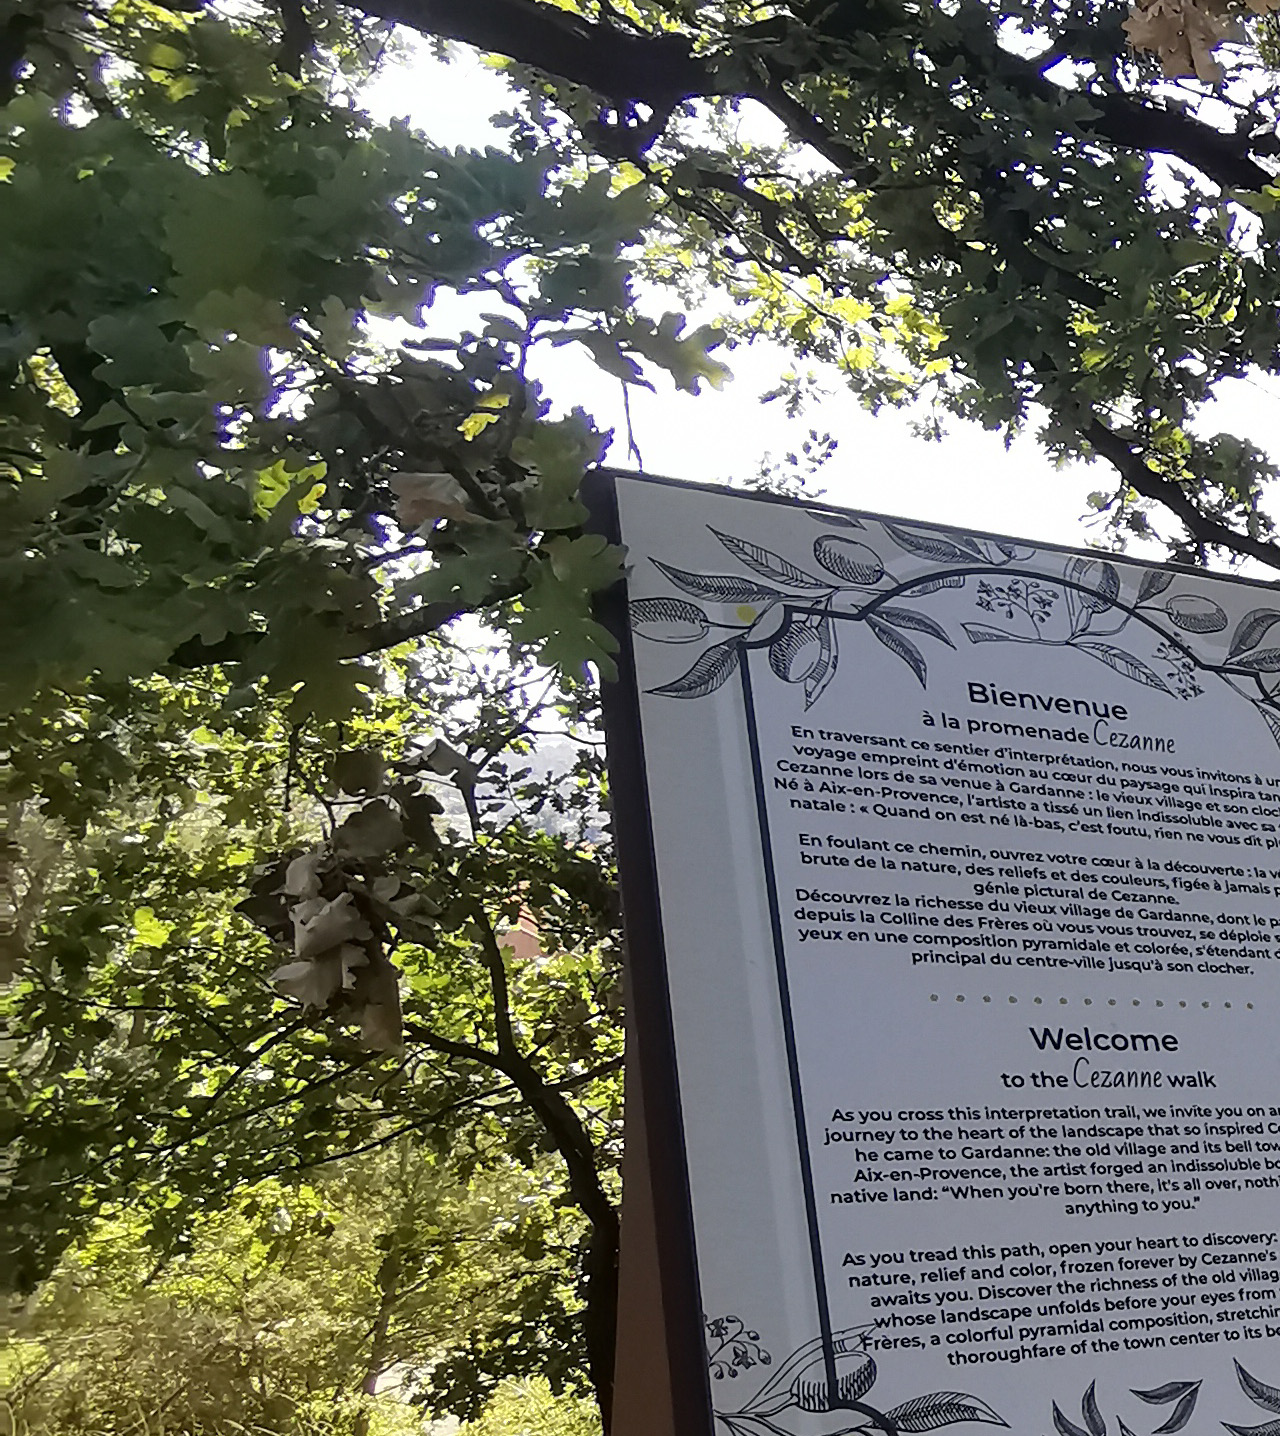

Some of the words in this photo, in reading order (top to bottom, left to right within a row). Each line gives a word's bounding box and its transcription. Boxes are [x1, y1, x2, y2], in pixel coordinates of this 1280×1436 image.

[967, 681, 1128, 721] Bienvenue
[922, 709, 936, 727] à
[941, 711, 961, 730] la
[966, 718, 1090, 744] promenade
[1093, 718, 1176, 754] Cezanne
[790, 725, 815, 740] En
[817, 729, 908, 749] traversant
[910, 740, 930, 751] ce
[933, 742, 991, 757] sentier
[993, 747, 1119, 773] d'interprétation,
[1121, 762, 1158, 775] nous
[1159, 766, 1195, 779] vous
[1195, 767, 1252, 785] invitons
[1254, 773, 1263, 786] à
[792, 744, 857, 763] voyage
[861, 752, 941, 769] empreint
[943, 758, 1026, 778] d'émotion
[1028, 769, 1049, 780] au
[1051, 771, 1093, 784] cœur
[1095, 773, 1117, 787] du
[1119, 778, 1180, 795] paysage
[1182, 783, 1207, 797] qui
[1208, 783, 1257, 801] inspira
[795, 888, 892, 906] Découvrez
[894, 893, 911, 907] la
[914, 894, 984, 911] richesse
[987, 898, 1010, 913] du
[1013, 900, 1058, 916] vieux
[1059, 902, 1111, 920] village
[1114, 906, 1135, 920] de
[1137, 908, 1215, 926] Gardanne,
[1215, 912, 1251, 926] dont
[1252, 913, 1267, 927] le
[973, 880, 1020, 896] génie
[1023, 883, 1085, 900] pictural
[1087, 887, 1108, 901] de
[1110, 889, 1180, 906] Cezanne.
[797, 928, 844, 943] yeux
[846, 931, 870, 942] en
[873, 931, 909, 944] une
[912, 933, 1018, 949] composition
[1021, 937, 1111, 953] pyramidale
[1114, 941, 1131, 953] et
[1133, 941, 1193, 958] colorée,
[1195, 944, 1272, 960] s'étendant
[911, 949, 987, 968] principal
[989, 952, 1013, 966] du
[1015, 955, 1106, 970] centre-ville
[1107, 956, 1164, 974] jusqu'à
[1166, 962, 1194, 973] son
[1196, 961, 1255, 976] clocher.
[1028, 1026, 1179, 1052] Welcome
[1000, 1072, 1025, 1089] to
[1029, 1070, 1069, 1088] the
[1073, 1056, 1163, 1089] Cezanne
[1166, 1070, 1217, 1088] walk
[823, 1127, 896, 1146] journey
[898, 1128, 919, 1141] to
[922, 1126, 954, 1141] the
[957, 1126, 1006, 1140] heart
[1008, 1125, 1026, 1139] of
[1028, 1124, 1058, 1139] the
[1061, 1123, 1144, 1140] landscape
[1146, 1123, 1181, 1137] that
[1183, 1125, 1202, 1136] so
[1203, 1121, 1265, 1138] inspired
[831, 1108, 855, 1122] As
[857, 1110, 893, 1125] you
[897, 1110, 945, 1121] cross
[947, 1106, 982, 1121] this
[984, 1105, 1101, 1123] interpretation
[1103, 1104, 1141, 1121] trail,
[1142, 1108, 1167, 1118] we
[1169, 1104, 1213, 1118] invite
[1214, 1107, 1244, 1120] you
[1246, 1107, 1266, 1117] on
[853, 1167, 1007, 1183] Aix-en-Provence,
[1009, 1163, 1040, 1178] the
[1042, 1161, 1088, 1177] artist
[1089, 1160, 1144, 1178] forged
[1147, 1163, 1168, 1174] an
[1169, 1157, 1262, 1173] indissoluble
[1064, 1198, 1139, 1218] anything
[1141, 1199, 1159, 1212] to
[1160, 1195, 1201, 1214] you."
[848, 1272, 916, 1288] nature,
[920, 1266, 967, 1284] relief
[970, 1263, 1005, 1280] and
[1009, 1262, 1057, 1278] color,
[1059, 1259, 1115, 1275] frozen
[1117, 1256, 1175, 1272] forever
[1177, 1253, 1198, 1270] by
[1201, 1249, 1278, 1266] Cezanne's
[870, 1289, 932, 1308] awaits
[934, 1290, 974, 1307] you.
[977, 1284, 1053, 1301] Discover
[1055, 1279, 1086, 1295] the
[1090, 1277, 1159, 1293] richness
[1161, 1273, 1178, 1288] of
[1181, 1271, 1208, 1287] the
[1211, 1269, 1236, 1284] old
[873, 1312, 937, 1330] whose
[940, 1306, 1033, 1325] landscape
[1036, 1298, 1101, 1317] unfolds
[1103, 1295, 1158, 1312] before
[1159, 1294, 1197, 1311] your
[1200, 1291, 1236, 1307] eyes
[1237, 1287, 1277, 1302] from
[862, 1334, 926, 1353] Frères,
[930, 1334, 941, 1346] a
[945, 1324, 1014, 1345] colorful
[1018, 1317, 1105, 1342] pyramidal
[1108, 1310, 1214, 1332] composition,
[946, 1343, 1066, 1366] thoroughfare
[1070, 1339, 1088, 1355] of
[1090, 1338, 1120, 1353] the
[1122, 1336, 1166, 1351] town
[1169, 1331, 1221, 1346] center
[1222, 1329, 1241, 1342] to
[1242, 1325, 1263, 1340] its
